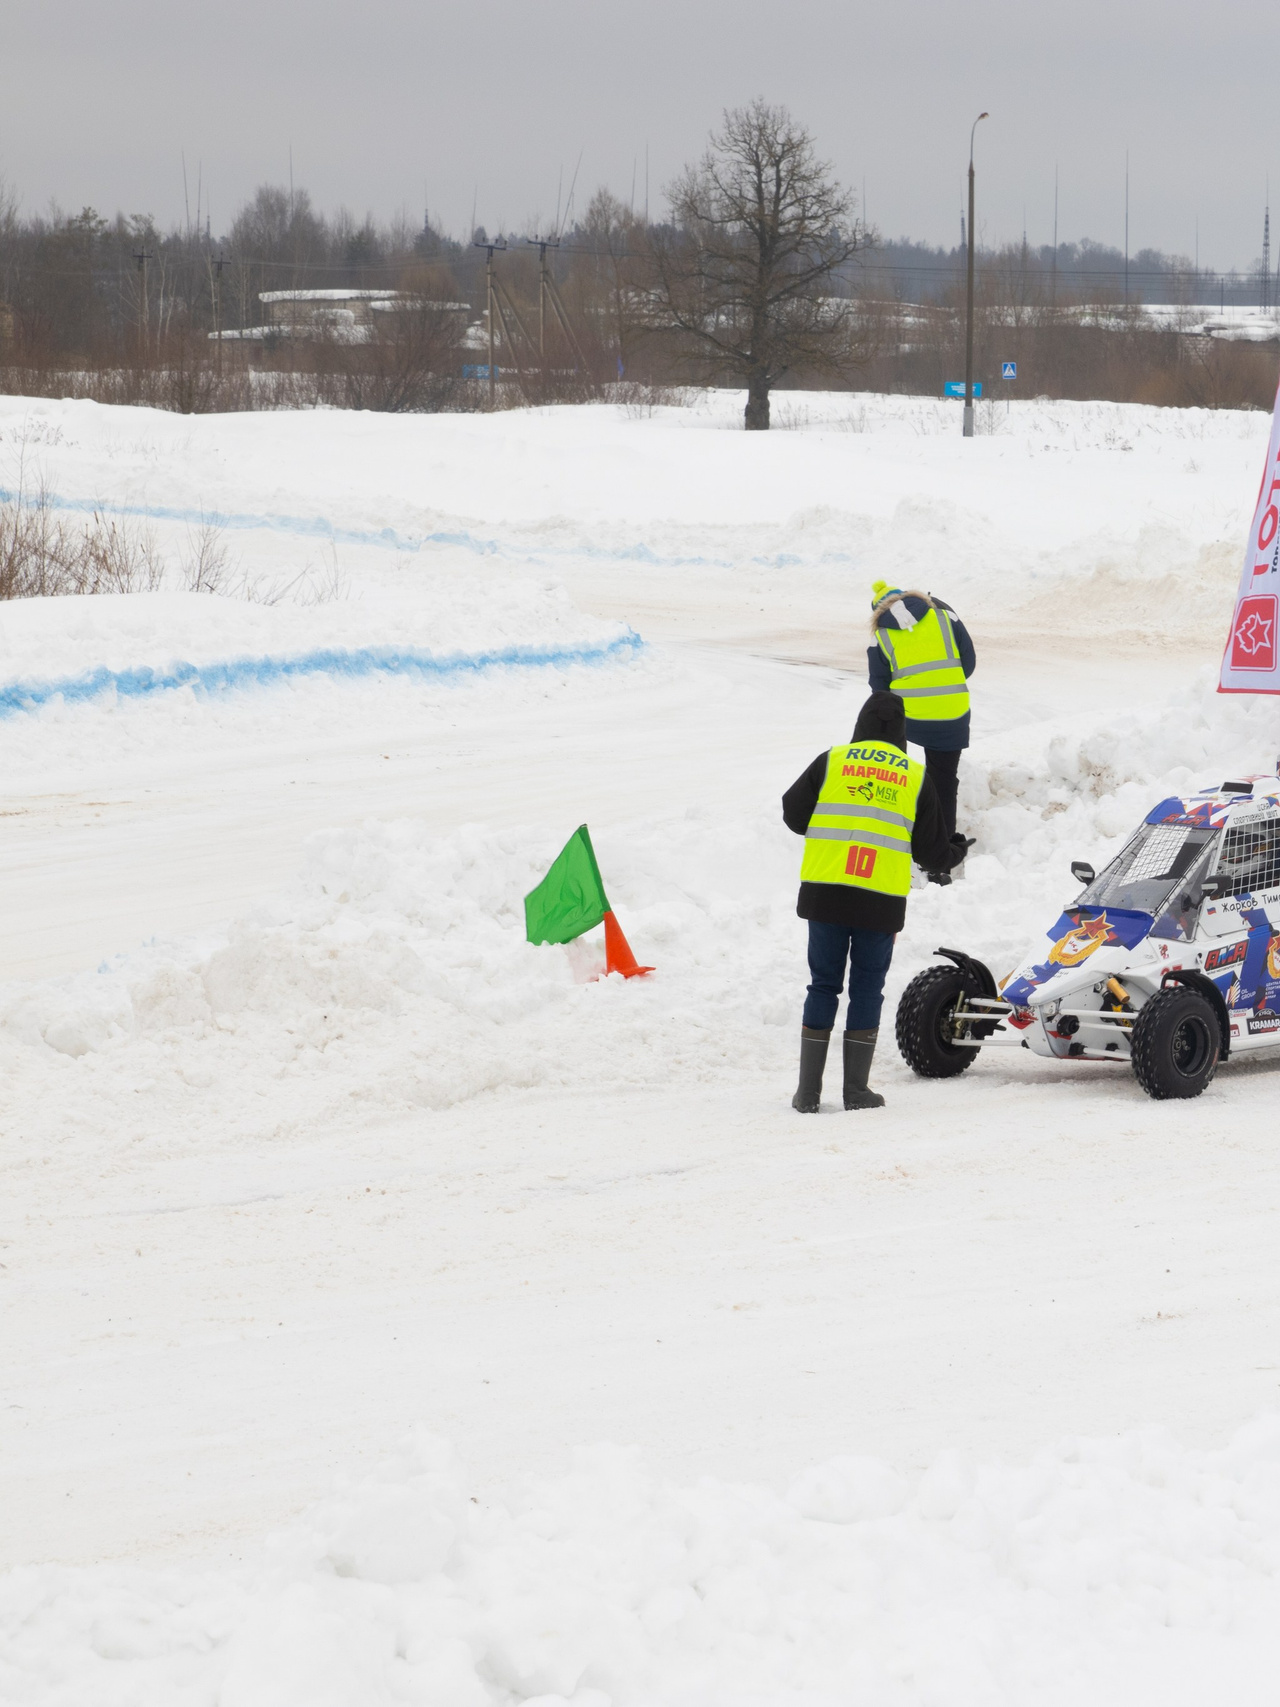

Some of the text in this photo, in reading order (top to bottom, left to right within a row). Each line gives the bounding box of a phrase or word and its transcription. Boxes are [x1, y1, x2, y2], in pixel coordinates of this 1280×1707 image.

[846, 748, 909, 770] RUSTA
[841, 765, 907, 787] МАРШАЛ
[875, 785, 898, 802] MSK
[845, 845, 877, 879] 10
[1221, 897, 1258, 912] Жарков
[1250, 1019, 1280, 1030] KRAMAR
